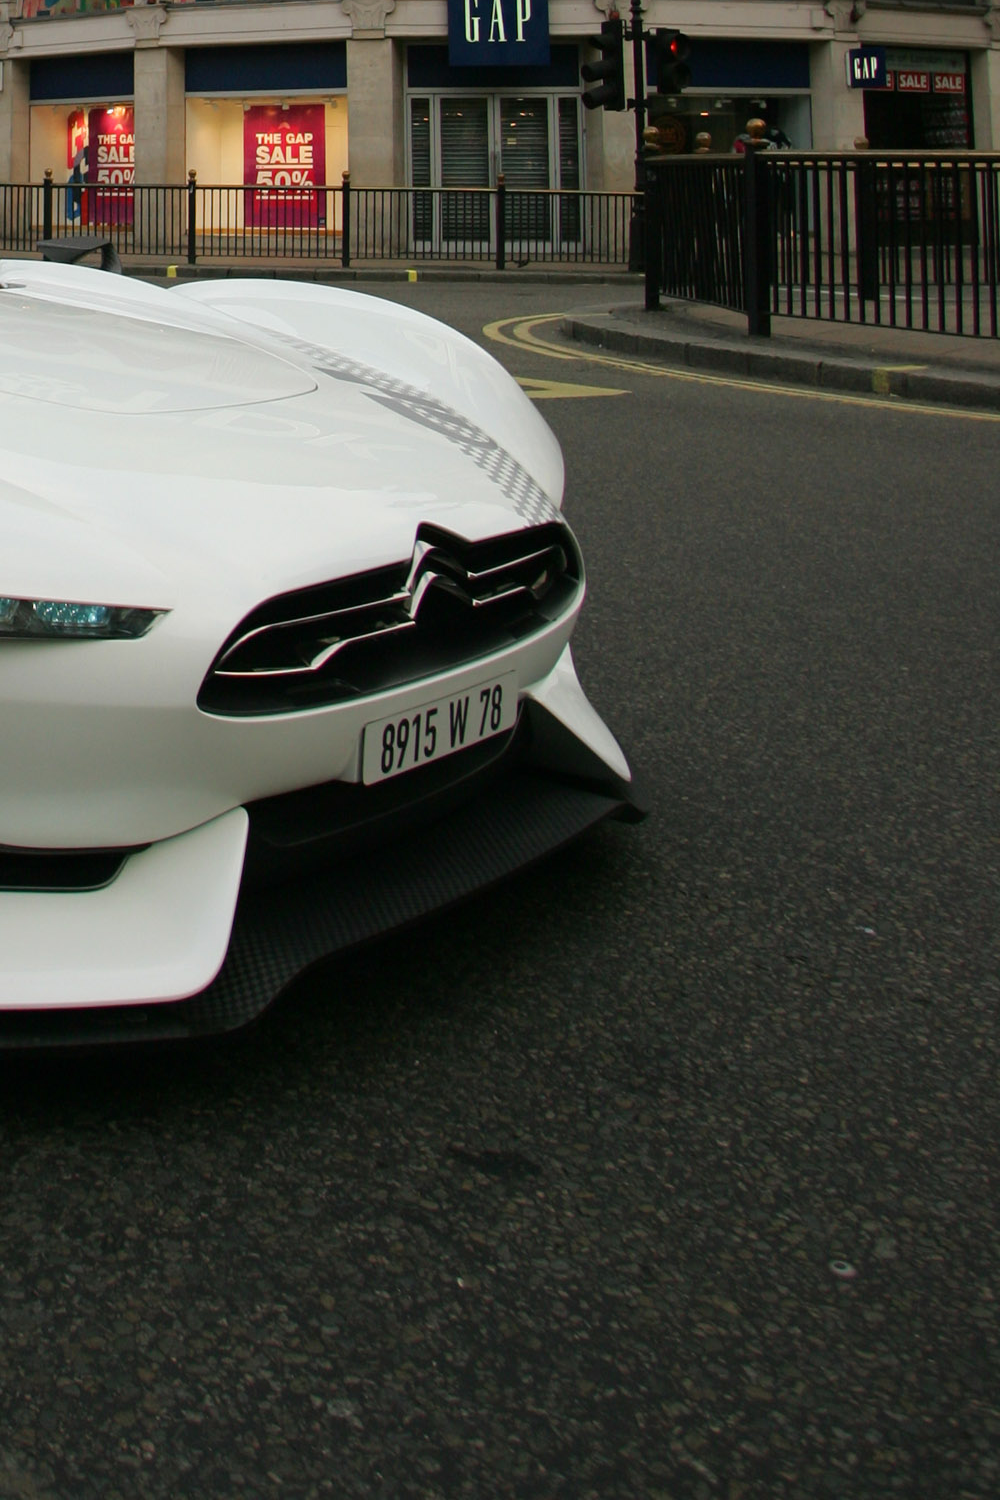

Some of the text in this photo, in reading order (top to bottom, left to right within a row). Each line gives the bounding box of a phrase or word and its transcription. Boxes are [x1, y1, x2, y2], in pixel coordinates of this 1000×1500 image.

[853, 55, 879, 81] GAP
[899, 74, 927, 88] SALE
[935, 76, 962, 89] SALE
[97, 134, 117, 145] THE
[256, 132, 314, 145] THE GAP
[255, 145, 314, 164] SALE
[256, 170, 314, 194] 50%
[380, 683, 503, 774] 8915 W 78
